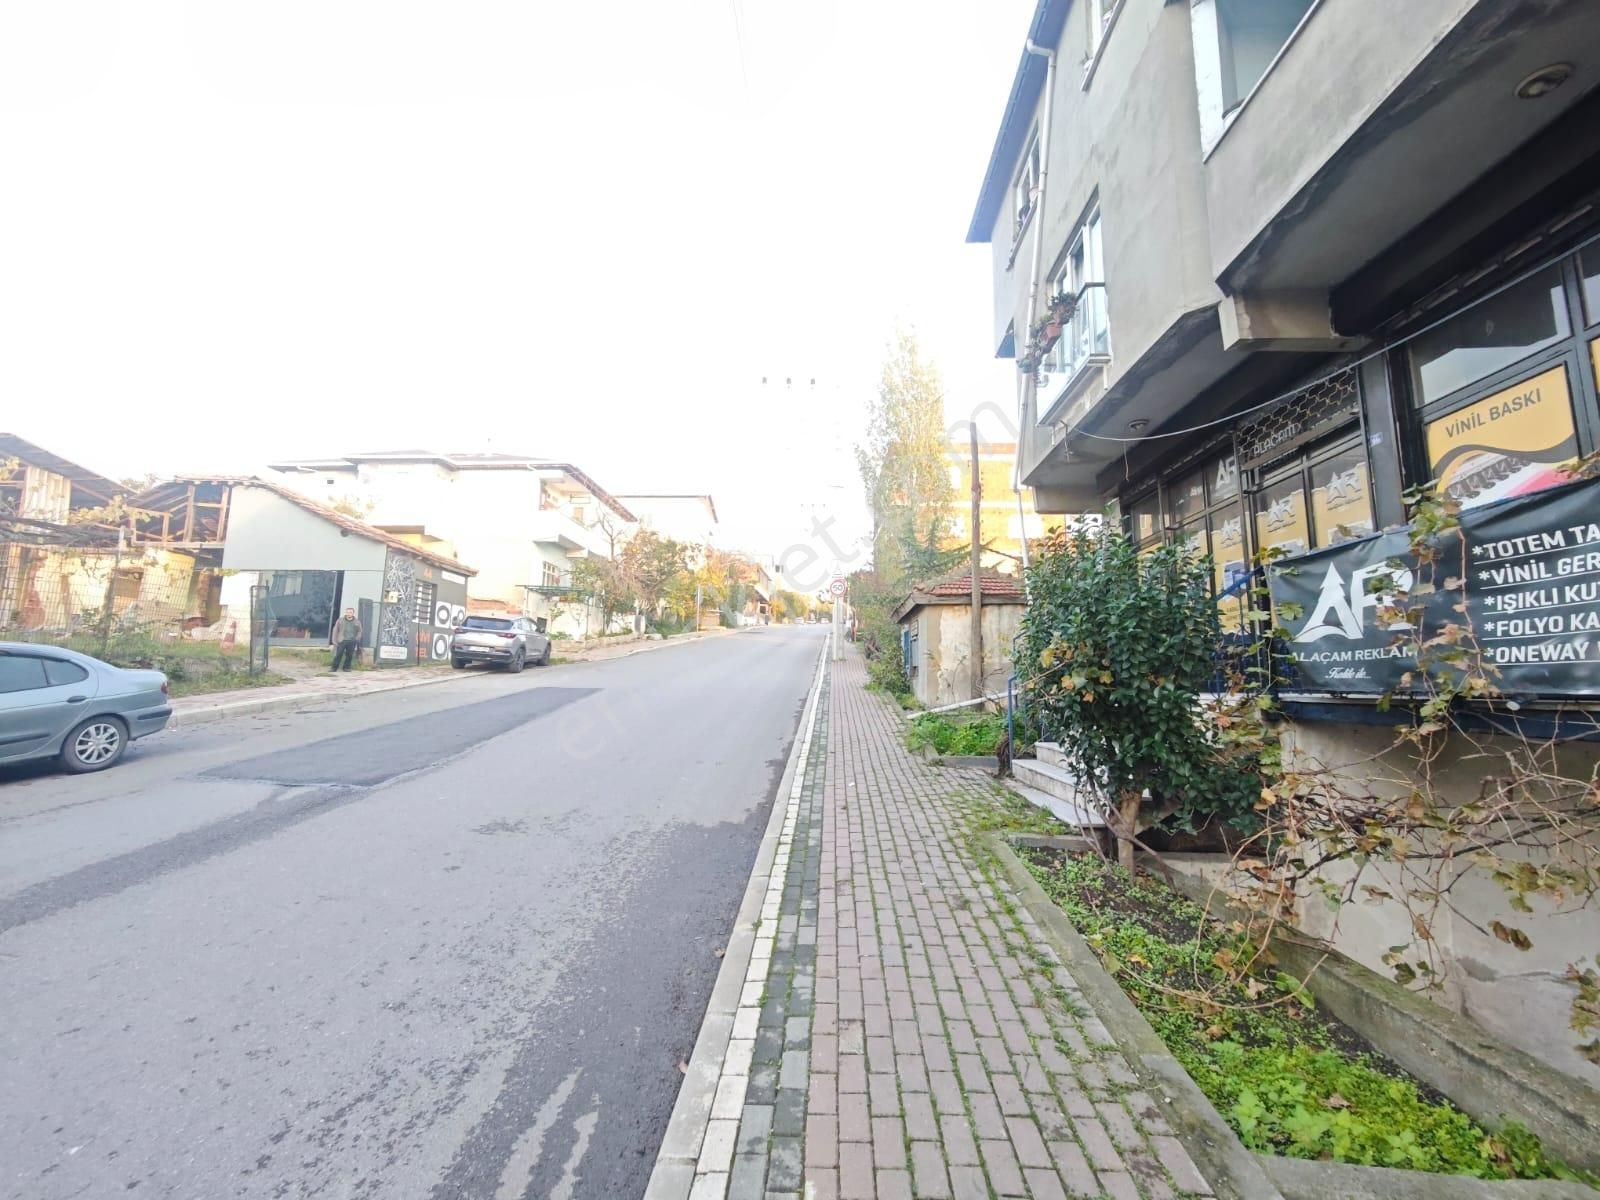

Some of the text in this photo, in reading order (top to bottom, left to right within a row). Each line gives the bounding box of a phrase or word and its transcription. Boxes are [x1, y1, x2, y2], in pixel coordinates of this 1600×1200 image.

[1445, 388, 1542, 438] VİNİL BASKI
[1565, 582, 1600, 604] KU
[1354, 646, 1418, 660] REKLAM
